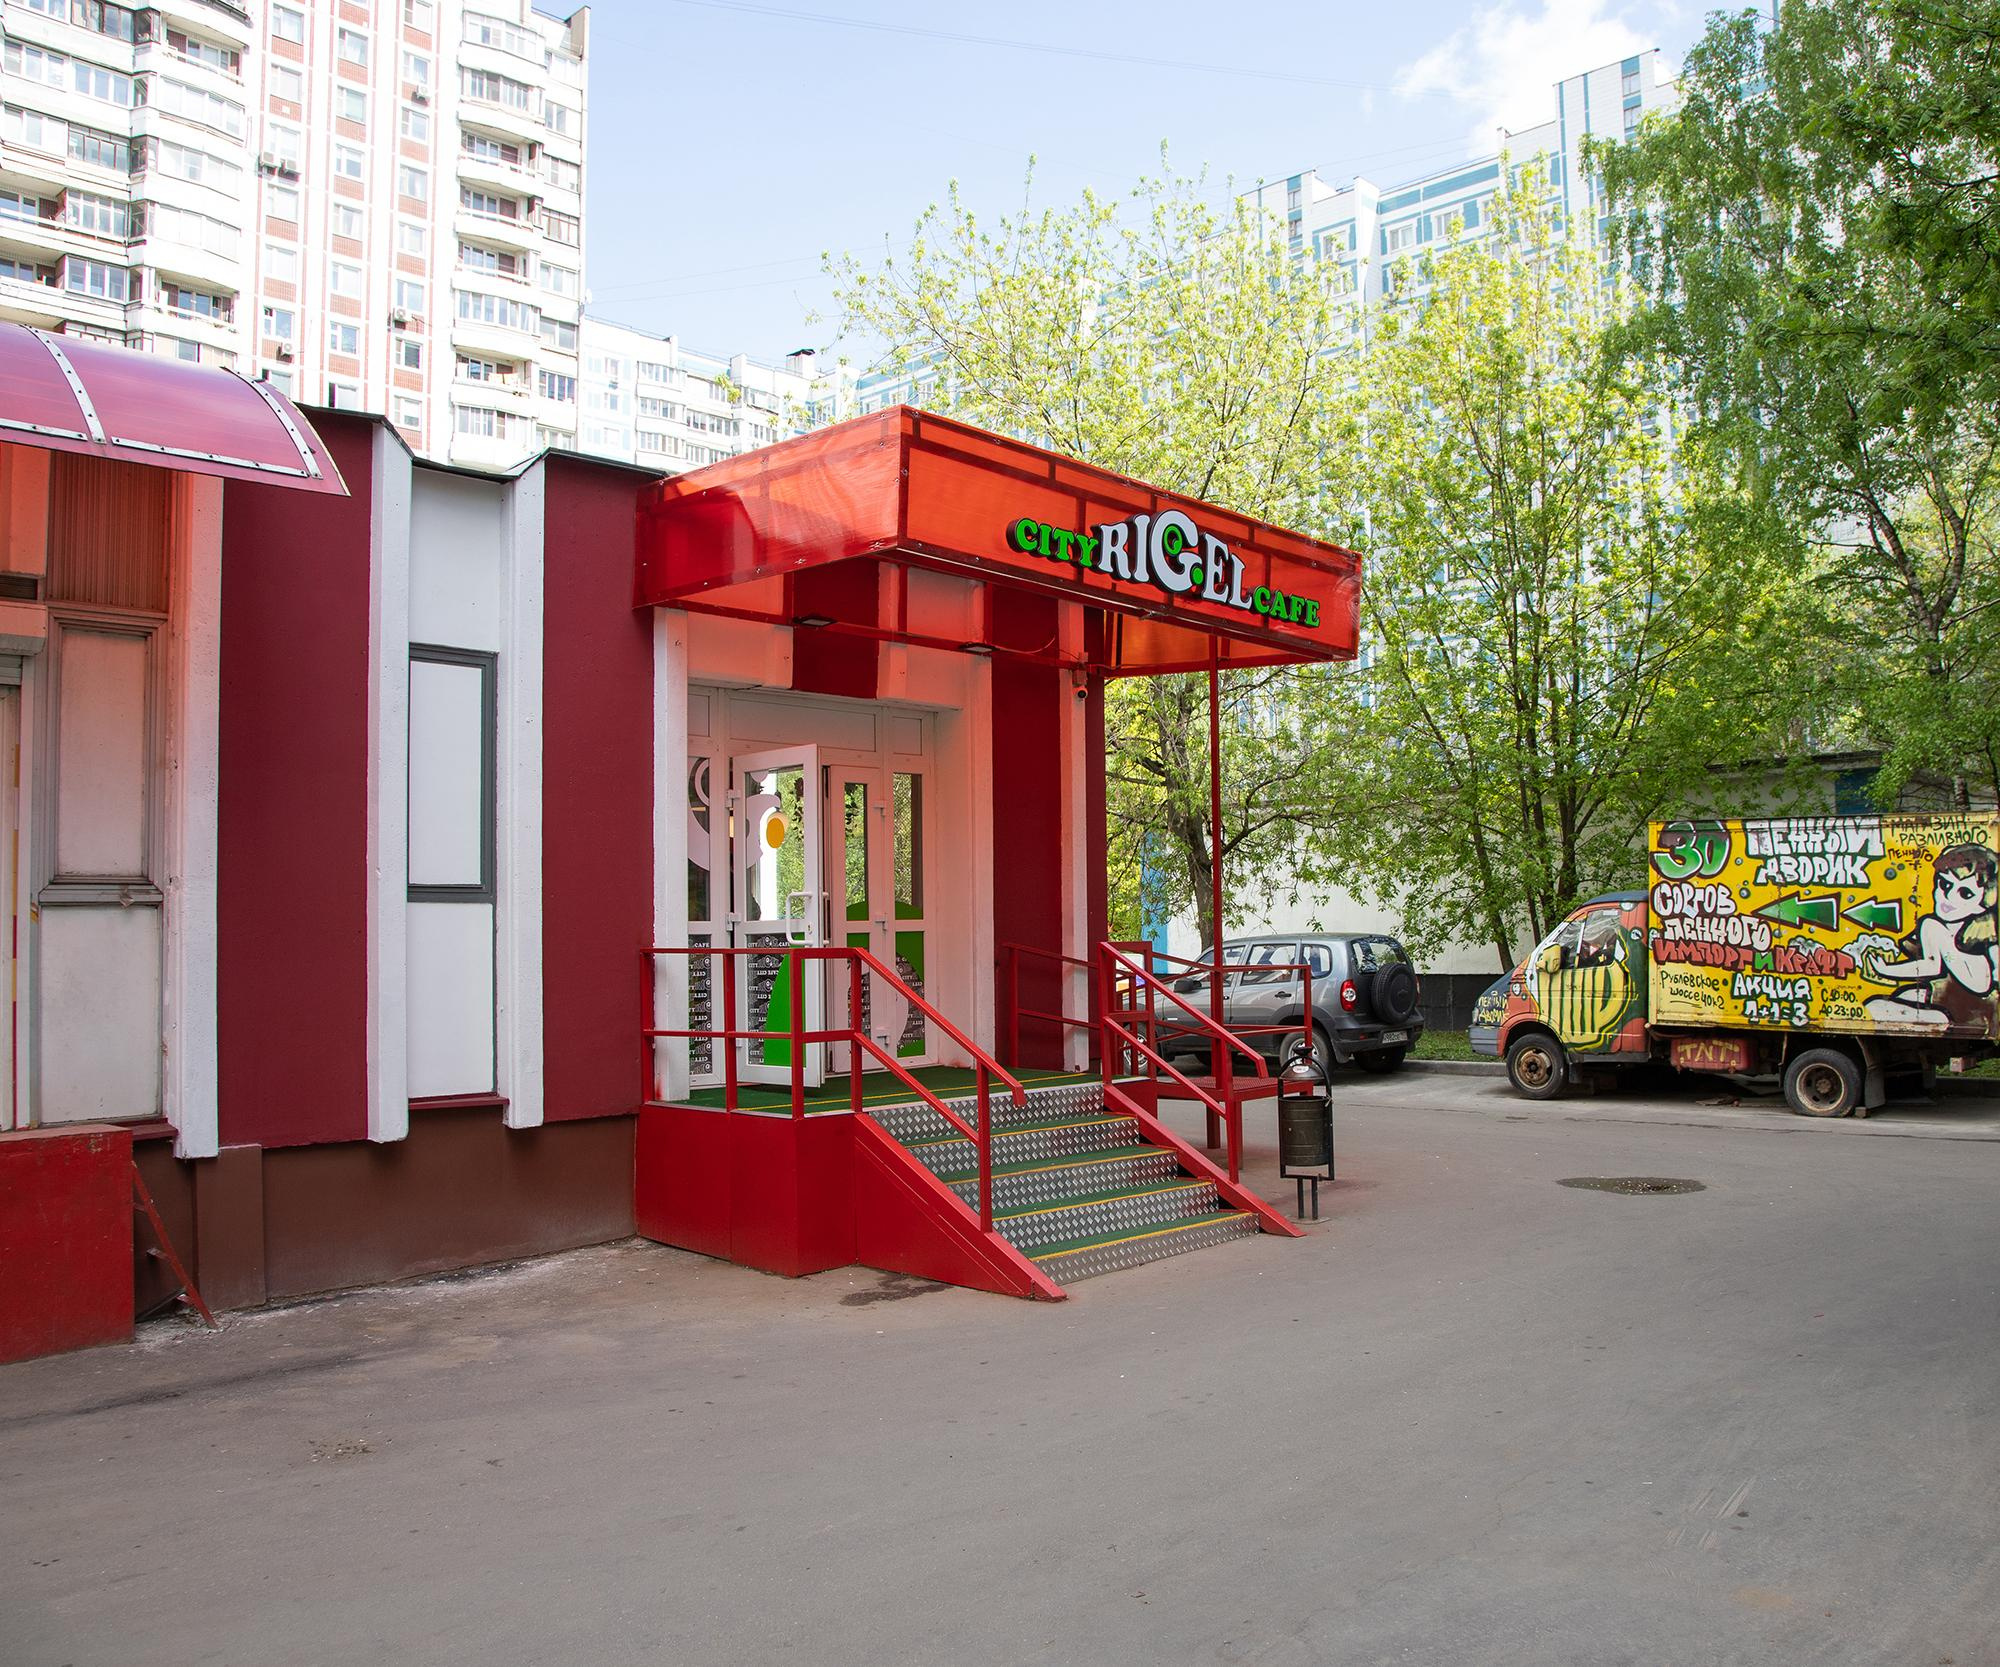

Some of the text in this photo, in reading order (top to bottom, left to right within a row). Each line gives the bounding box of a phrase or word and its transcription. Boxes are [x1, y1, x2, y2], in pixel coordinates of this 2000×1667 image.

[1012, 508, 1321, 628] CITY RIGEL CAFE
[1651, 820, 1731, 880] 30
[1756, 854, 1869, 884] ДВОРИК
[1653, 882, 1737, 917] СОРТОВ
[1663, 915, 1771, 951] ПЕННОГО
[1655, 939, 1854, 977] ИМПОРТ И КРАФТ
[1478, 993, 1508, 1009] ПЕЫЙ
[1734, 974, 1811, 1000] АКЦИЯ
[1745, 1000, 1809, 1026] 1+1=3
[1678, 1040, 1739, 1062] TNT
